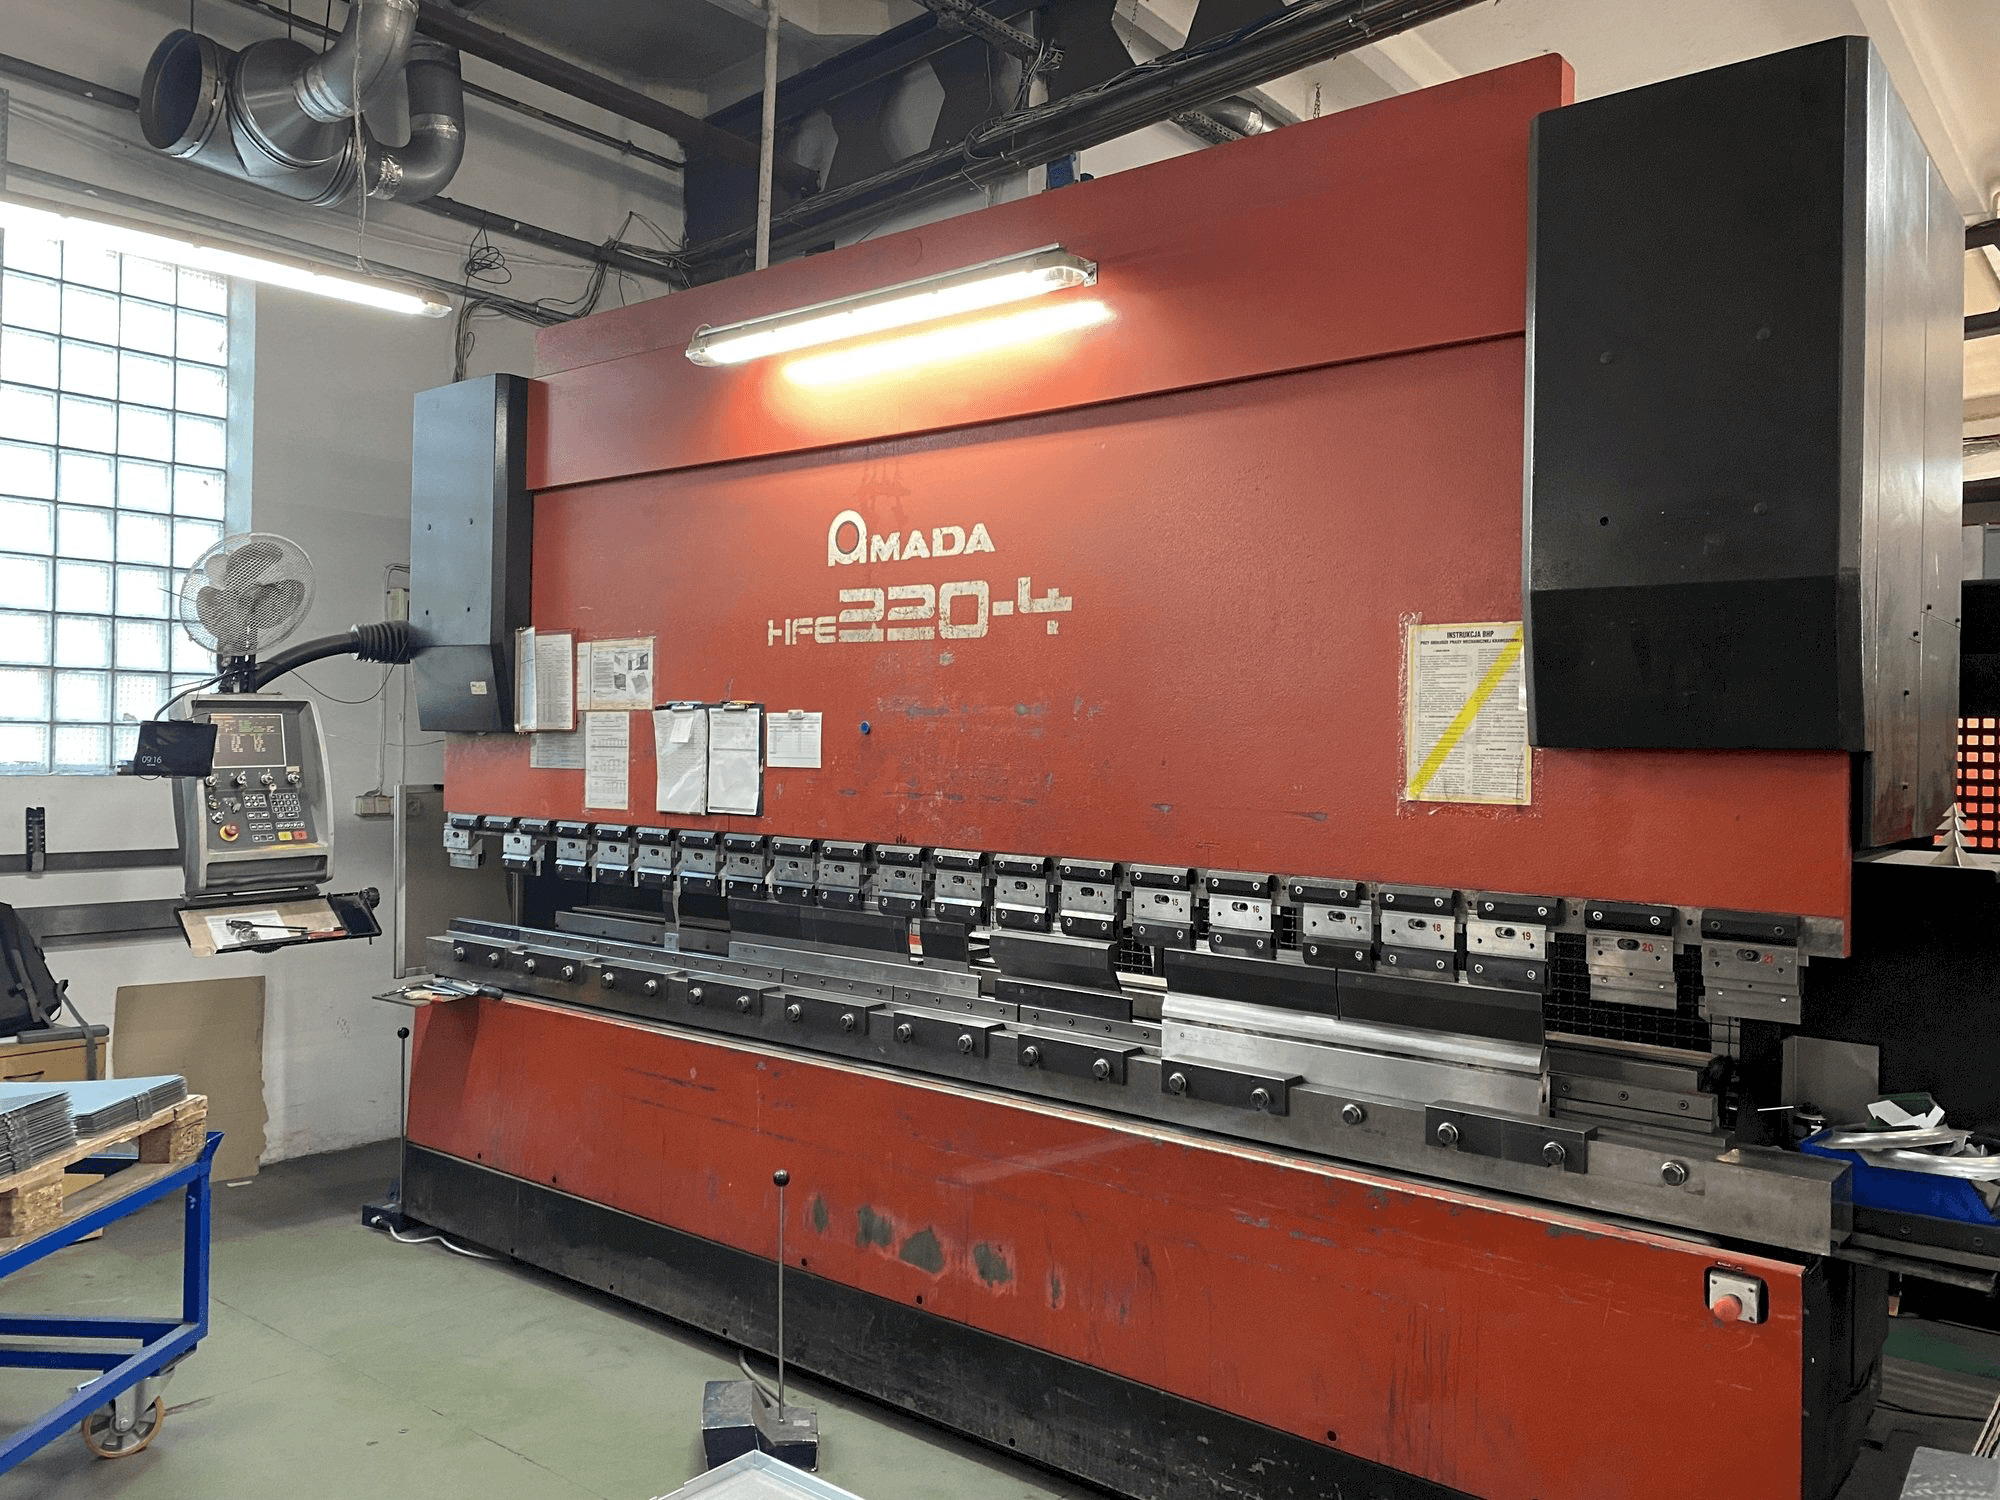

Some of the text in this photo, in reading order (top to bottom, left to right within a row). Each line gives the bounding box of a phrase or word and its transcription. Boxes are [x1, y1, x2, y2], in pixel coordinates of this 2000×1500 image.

[828, 509, 996, 567] AMADA
[1447, 630, 1494, 639] INSTRUKCJA BHP
[1096, 890, 1103, 898] 14
[1171, 898, 1179, 906] 15
[1252, 905, 1260, 913] 16
[1350, 916, 1358, 925] 17
[1432, 923, 1441, 932] 18
[1522, 931, 1531, 940] 19
[1642, 942, 1654, 953] 20
